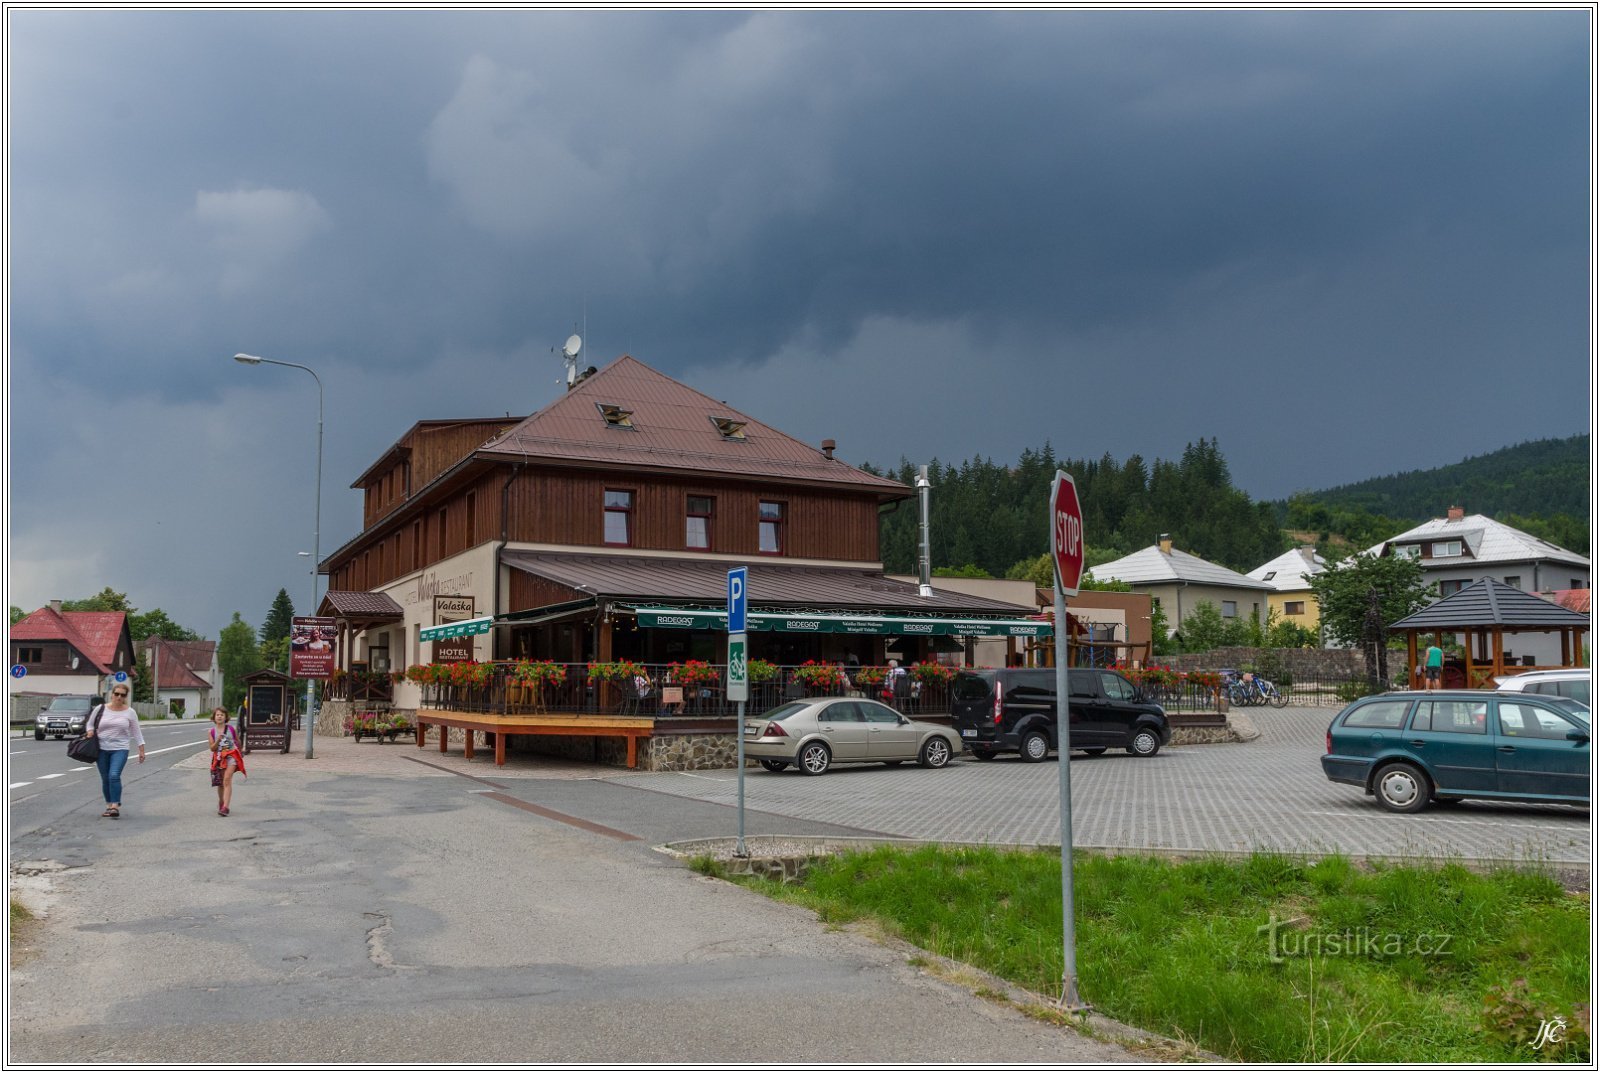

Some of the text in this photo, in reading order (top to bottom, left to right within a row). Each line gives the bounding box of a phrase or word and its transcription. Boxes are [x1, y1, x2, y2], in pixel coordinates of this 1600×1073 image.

[1057, 510, 1080, 557] STOP
[441, 572, 473, 595] RESTAURANT
[731, 577, 742, 614] P
[437, 600, 471, 611] Valaška
[657, 616, 694, 626] RADEGAST
[786, 620, 820, 630] RADEGAST
[904, 624, 934, 633] RADEGAST
[1009, 626, 1038, 634] RADEGAST
